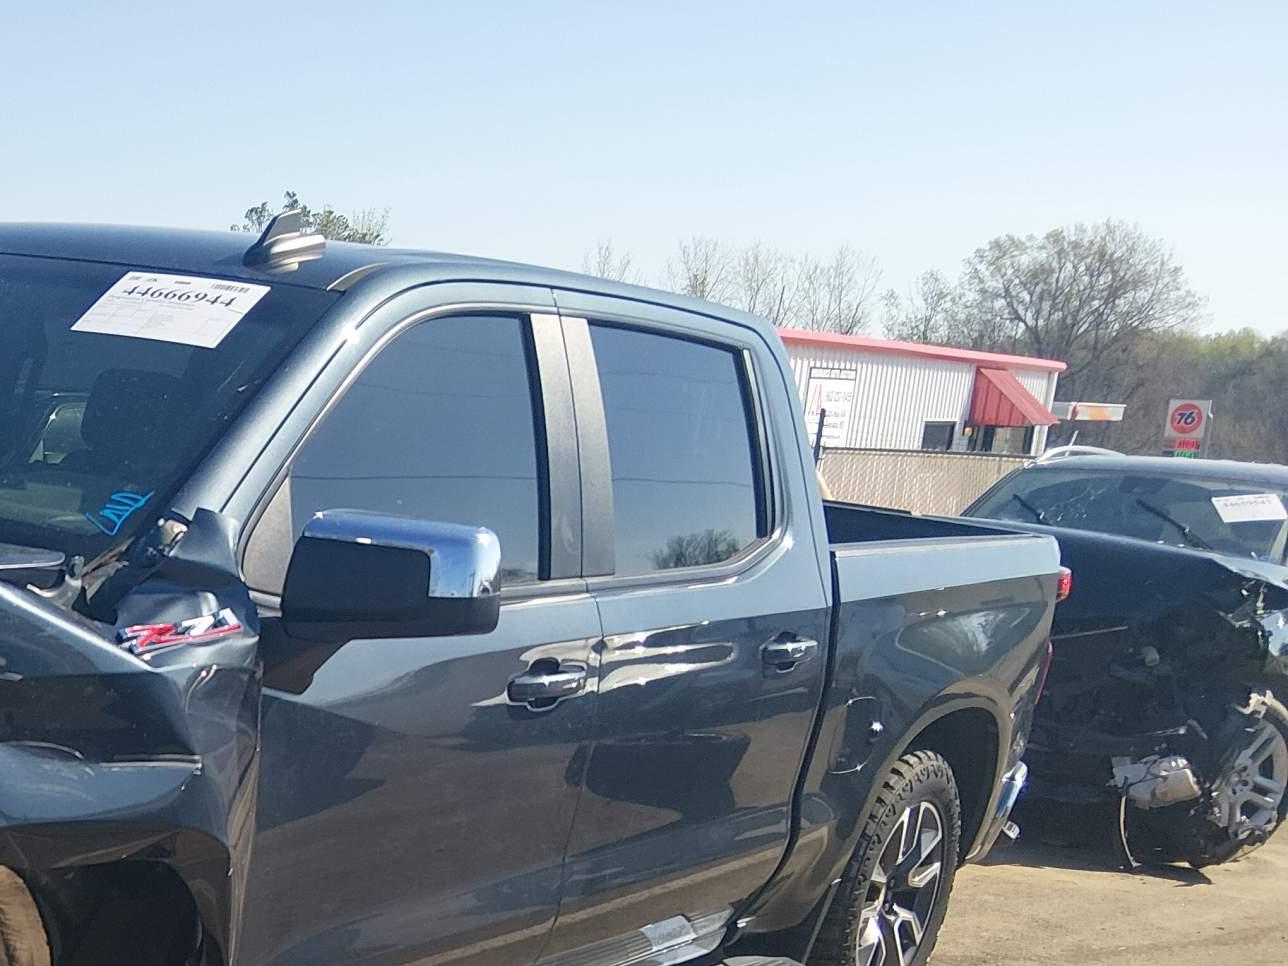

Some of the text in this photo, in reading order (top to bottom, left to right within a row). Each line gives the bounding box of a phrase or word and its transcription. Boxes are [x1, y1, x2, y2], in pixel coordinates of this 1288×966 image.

[122, 284, 238, 308] 44666944
[1176, 412, 1196, 426] 76
[118, 608, 242, 654] Z71
